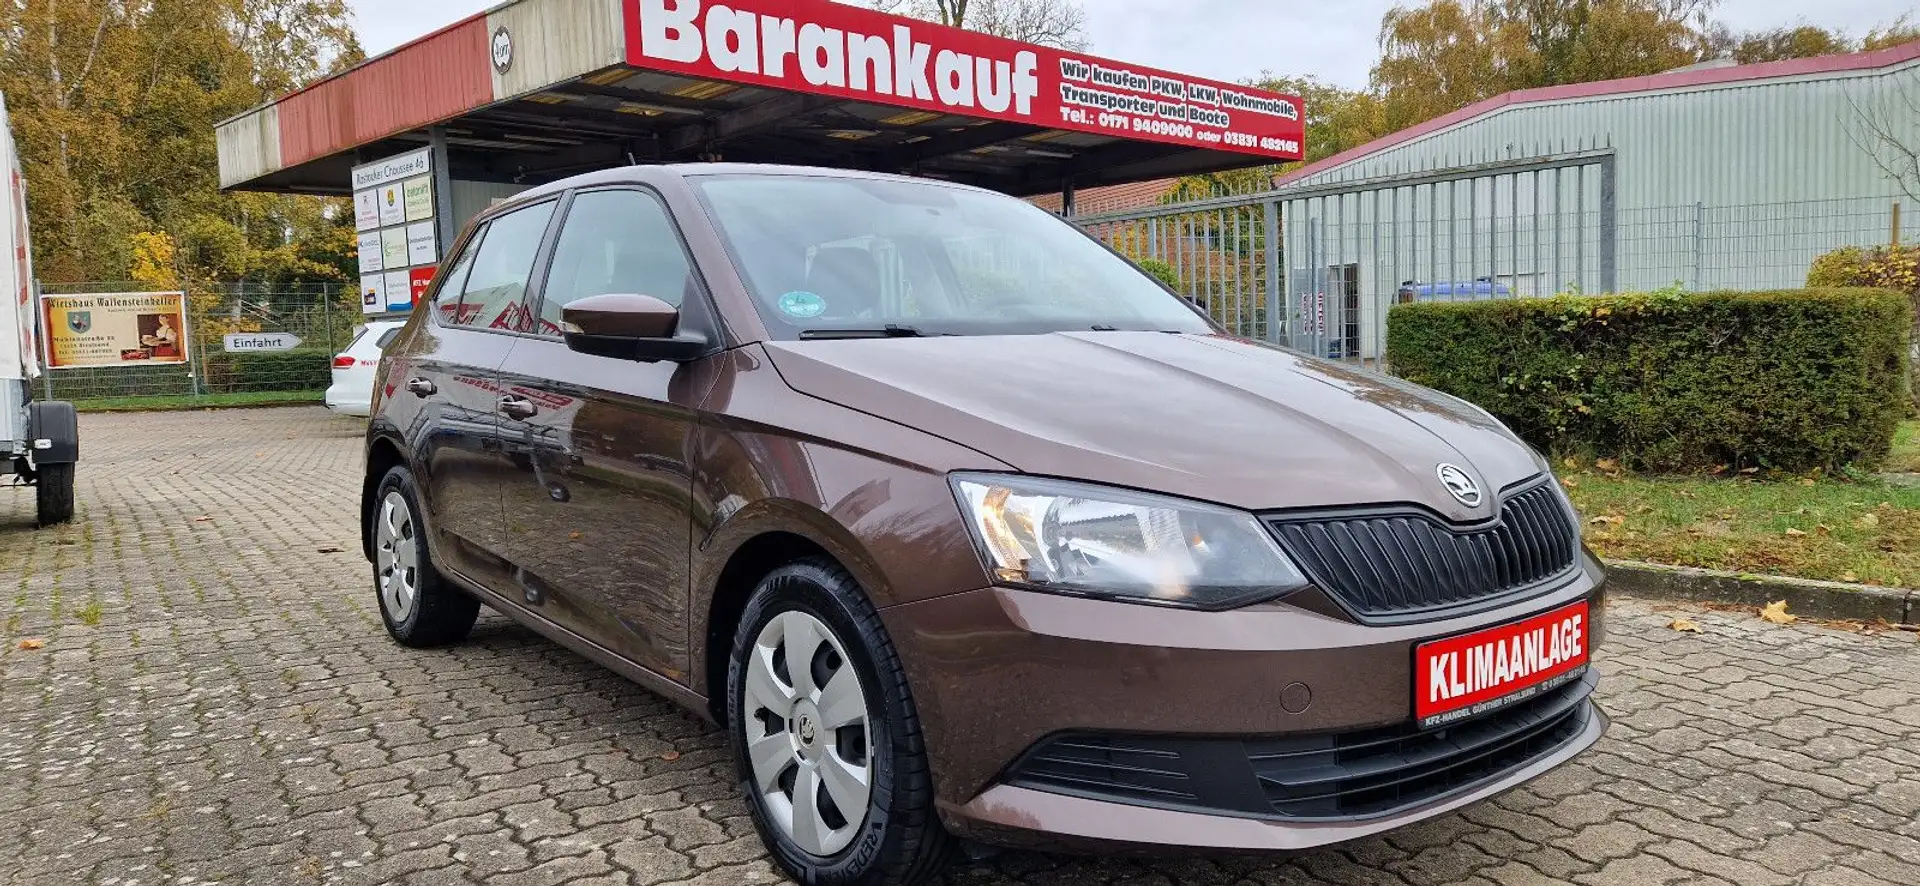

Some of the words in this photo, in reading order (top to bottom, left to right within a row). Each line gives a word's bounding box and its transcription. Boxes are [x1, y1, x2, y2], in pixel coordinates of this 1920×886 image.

[638, 0, 1038, 115] Barankauf
[1061, 59, 1090, 81] Wir
[1092, 65, 1148, 91] kaufen
[1151, 77, 1187, 100] PKW,
[1189, 84, 1220, 106] LKW,
[1221, 90, 1297, 119] Wohnmobile,
[1061, 83, 1155, 115] Transporter
[1158, 102, 1187, 121] und
[1189, 106, 1228, 127] Boote
[1060, 107, 1094, 124] Tel.:
[1098, 113, 1129, 130] 0171
[1197, 131, 1221, 142] oder
[233, 338, 282, 348] Einfahrt
[1430, 614, 1582, 703] KLIMAANLAGE
[1425, 708, 1471, 727] KFZ-HANDEL
[1472, 698, 1501, 714] GÜNTHER
[1503, 687, 1536, 705] STRALSUND
